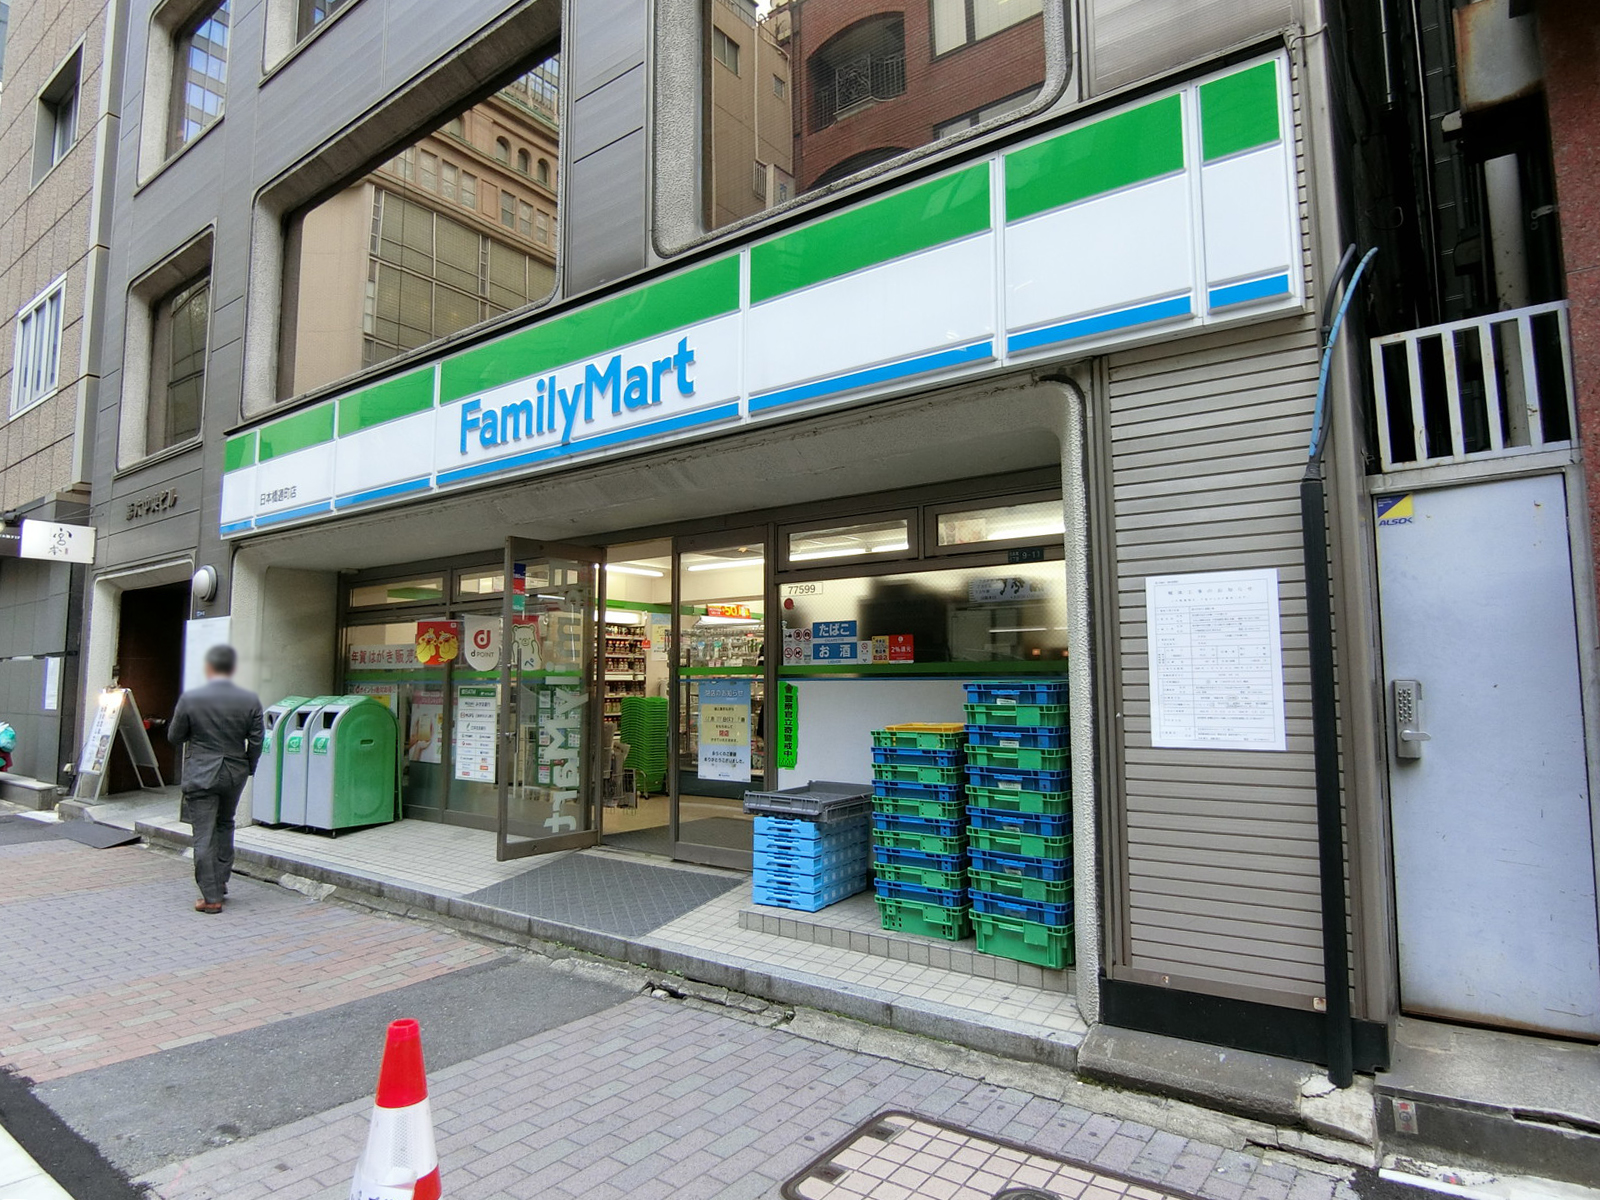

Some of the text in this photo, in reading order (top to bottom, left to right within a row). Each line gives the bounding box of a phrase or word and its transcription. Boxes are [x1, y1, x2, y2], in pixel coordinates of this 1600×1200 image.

[460, 336, 696, 455] FamilyMart
[1379, 516, 1412, 526] ALSOK
[788, 585, 816, 595] 77599
[819, 623, 850, 636] たばこ
[351, 647, 420, 665] 年賀はがき販売
[784, 695, 793, 757] 警察官立寄警戒中
